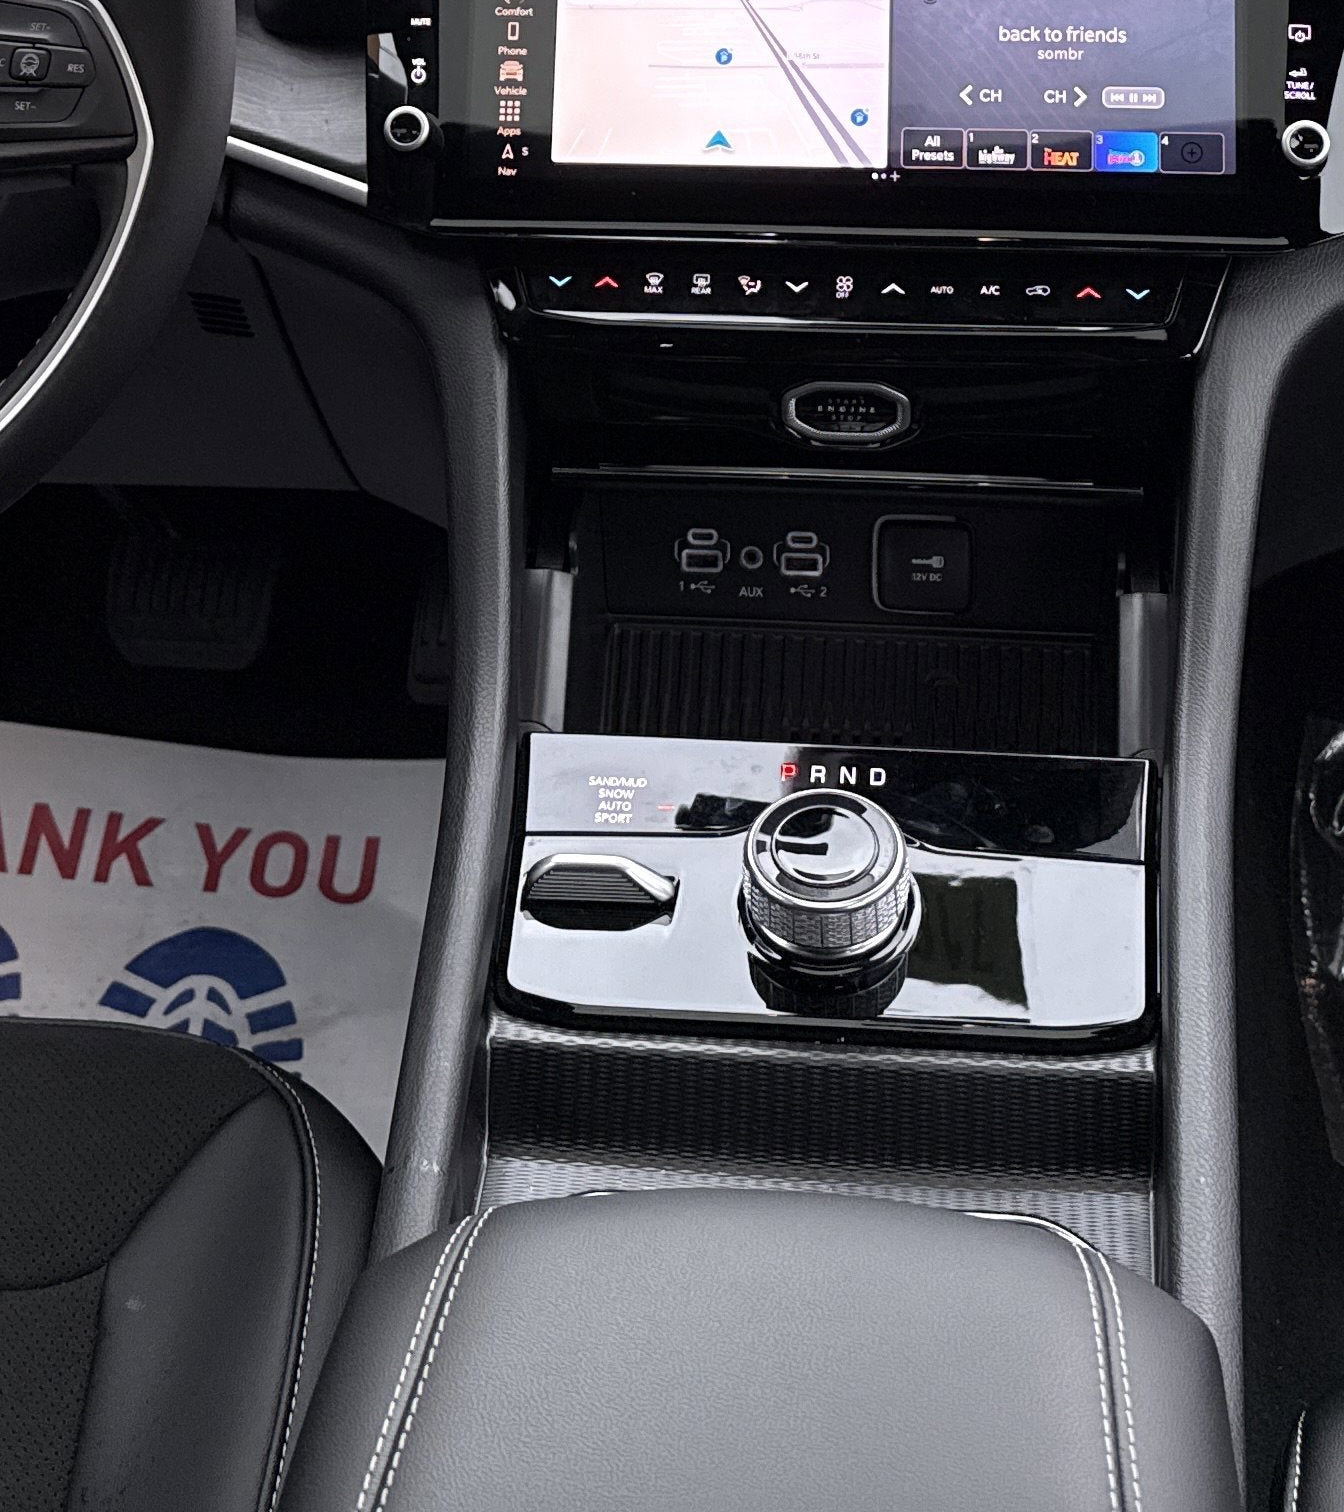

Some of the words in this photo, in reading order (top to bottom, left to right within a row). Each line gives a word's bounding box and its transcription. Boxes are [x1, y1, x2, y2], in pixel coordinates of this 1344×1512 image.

[494, 6, 533, 17] Comfort
[998, 25, 1041, 43] back
[1044, 27, 1062, 43] to
[1066, 25, 1127, 44] friends
[497, 45, 528, 56] Phone
[1037, 47, 1084, 61] sombr
[66, 63, 85, 74] RES
[493, 86, 528, 96] Vehicle
[979, 89, 1003, 104] CH
[1283, 90, 1316, 101] SCROLL
[1043, 90, 1068, 104] CH
[496, 126, 522, 137] Apps
[924, 135, 941, 148] All
[968, 132, 974, 143] 1
[1031, 132, 1040, 144] 2
[1095, 134, 1104, 145] 3
[1161, 135, 1170, 146] 4
[521, 146, 529, 157] S
[911, 149, 955, 162] Presets
[1043, 150, 1080, 166] HEAT
[497, 166, 518, 177] Nav
[644, 285, 664, 295] MAX
[690, 286, 712, 295] REAR
[835, 291, 850, 299] OFF
[930, 285, 954, 295] AUTO
[980, 284, 1001, 296] A/C
[817, 404, 876, 414] ENGINE
[911, 571, 928, 582] 12V
[929, 571, 943, 582] DC
[738, 586, 764, 598] AUX
[819, 586, 827, 598] 2
[780, 761, 798, 782] P
[810, 764, 827, 783] R
[839, 765, 857, 785] N
[870, 767, 887, 787] D
[588, 775, 649, 788] SAND/MUD
[598, 787, 635, 800] SNOW
[597, 800, 632, 812] AUTO
[594, 811, 633, 824] SPORT
[193, 821, 381, 905] YOU
